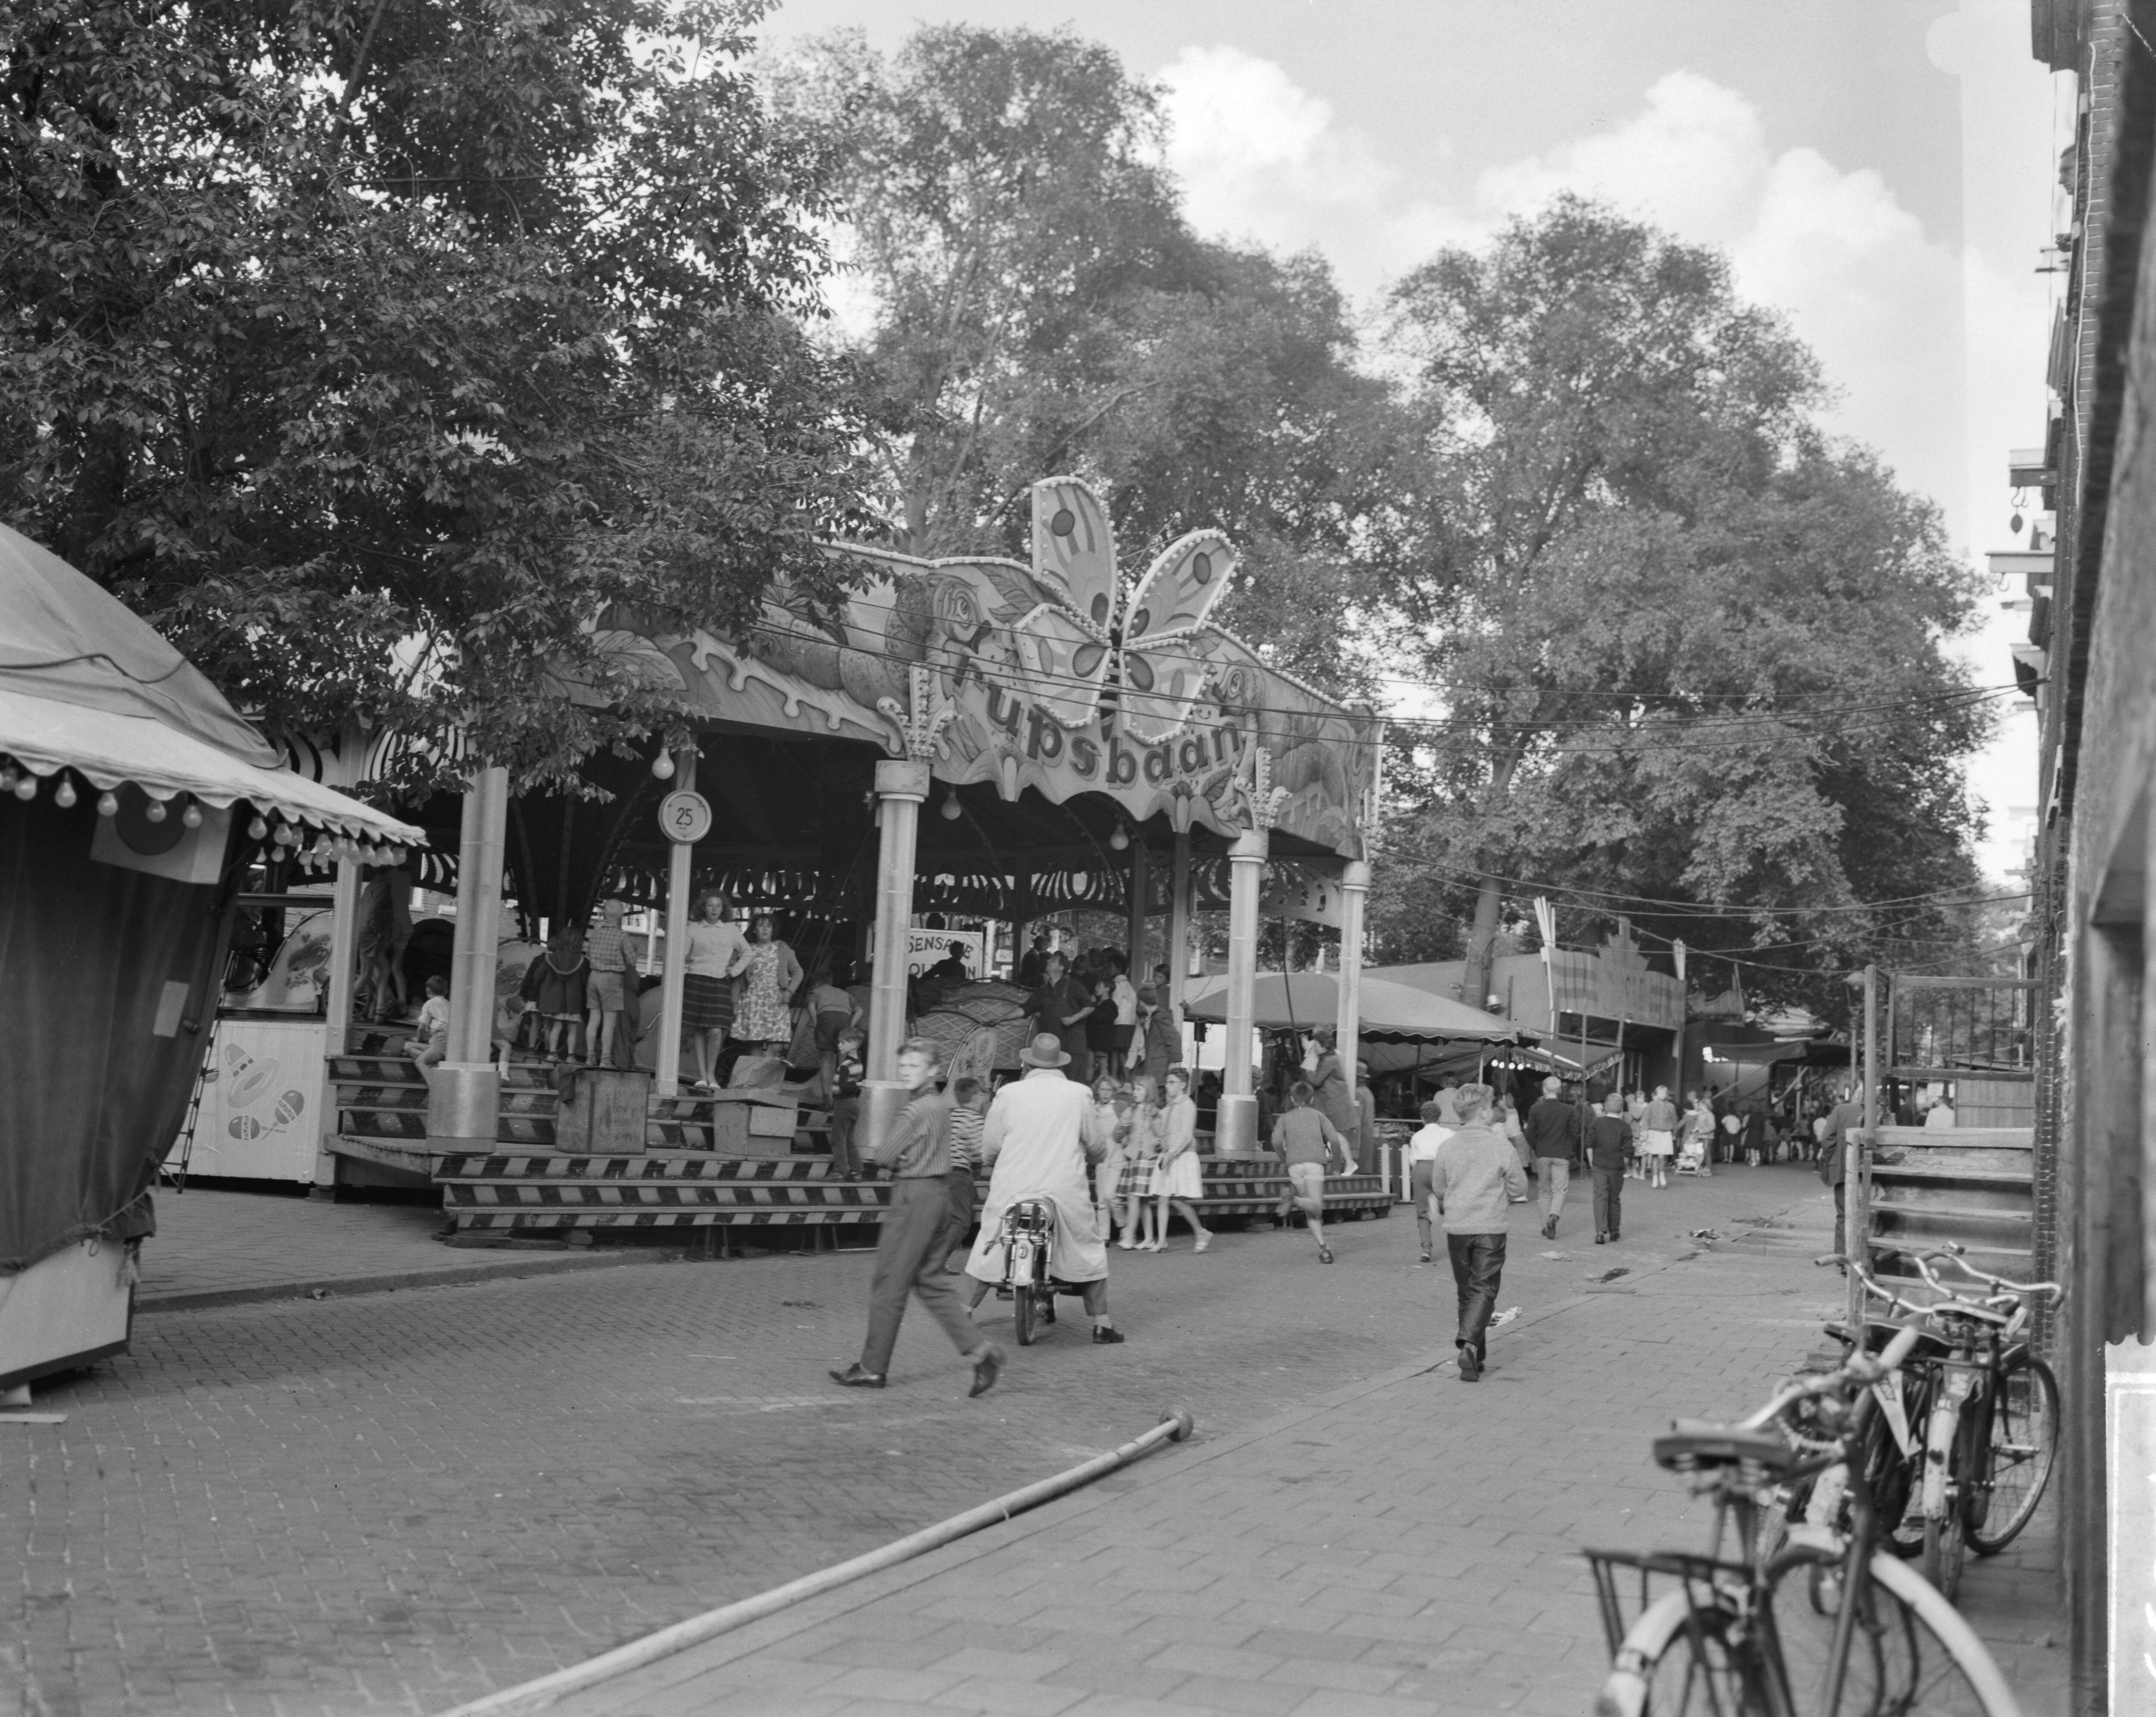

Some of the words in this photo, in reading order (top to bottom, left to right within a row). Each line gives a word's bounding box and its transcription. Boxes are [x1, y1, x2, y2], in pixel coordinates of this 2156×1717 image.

[952, 653, 1243, 786] rupsbaan
[676, 807, 693, 826] 25
[909, 936, 974, 959] SENSAE
